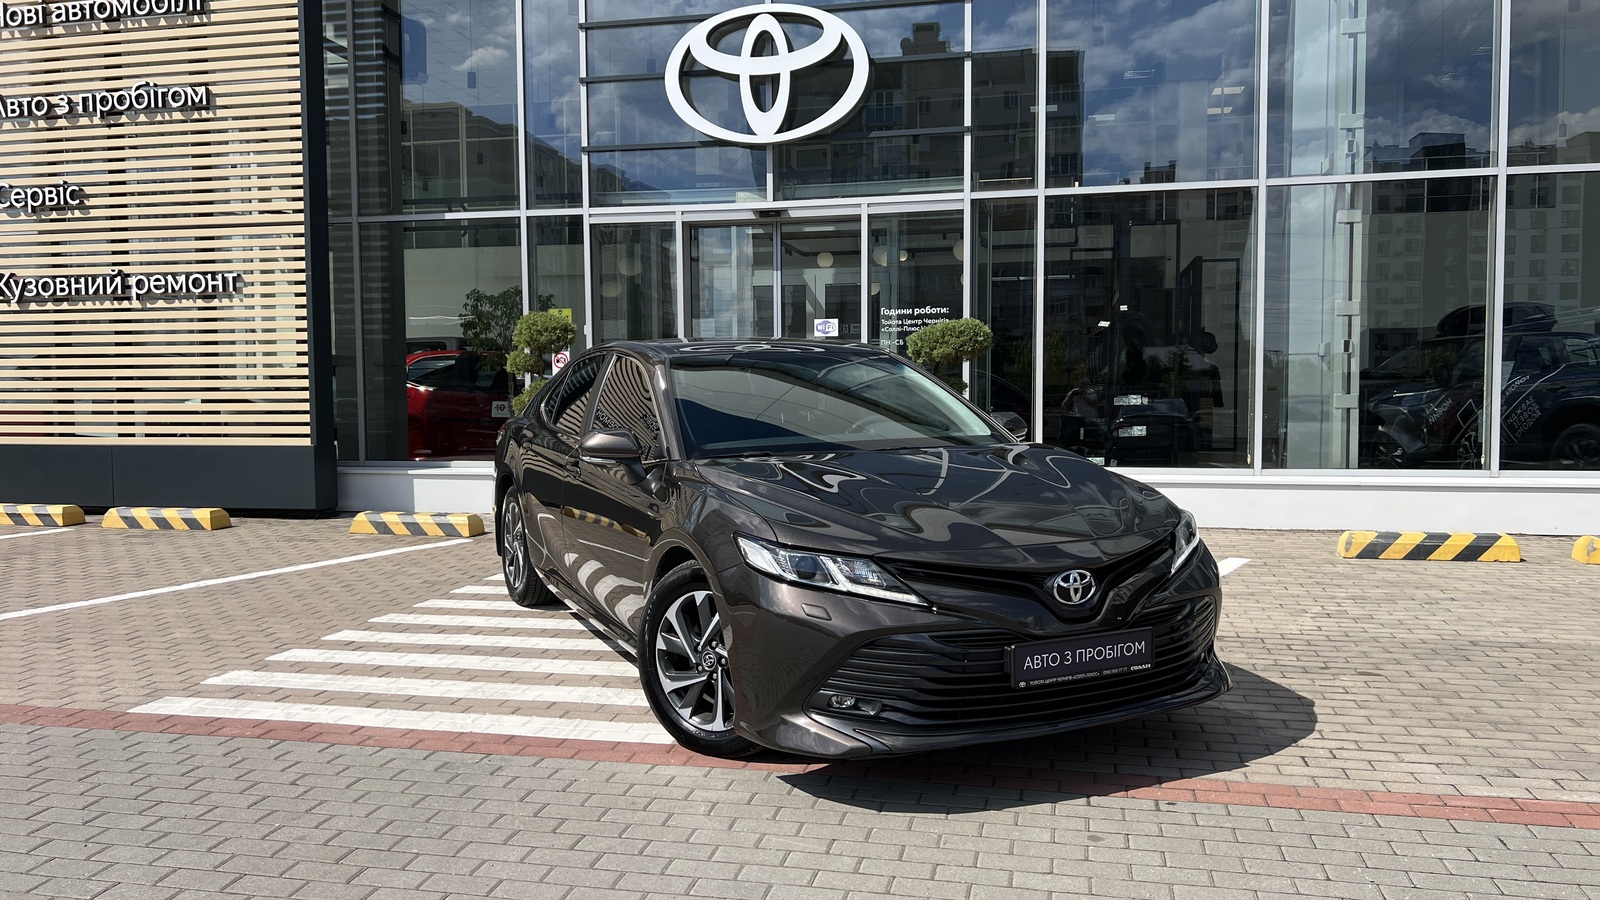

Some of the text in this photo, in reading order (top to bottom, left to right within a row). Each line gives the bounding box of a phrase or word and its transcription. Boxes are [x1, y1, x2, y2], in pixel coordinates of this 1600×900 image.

[0, 0, 43, 27] ові
[56, 94, 69, 114] з
[79, 81, 207, 118] пробігом
[0, 180, 80, 213] Сервіс
[132, 273, 238, 301] ремонт
[880, 306, 950, 317] Години роботи:
[1023, 640, 1146, 670] АВТО З ПРОБІГОМ
